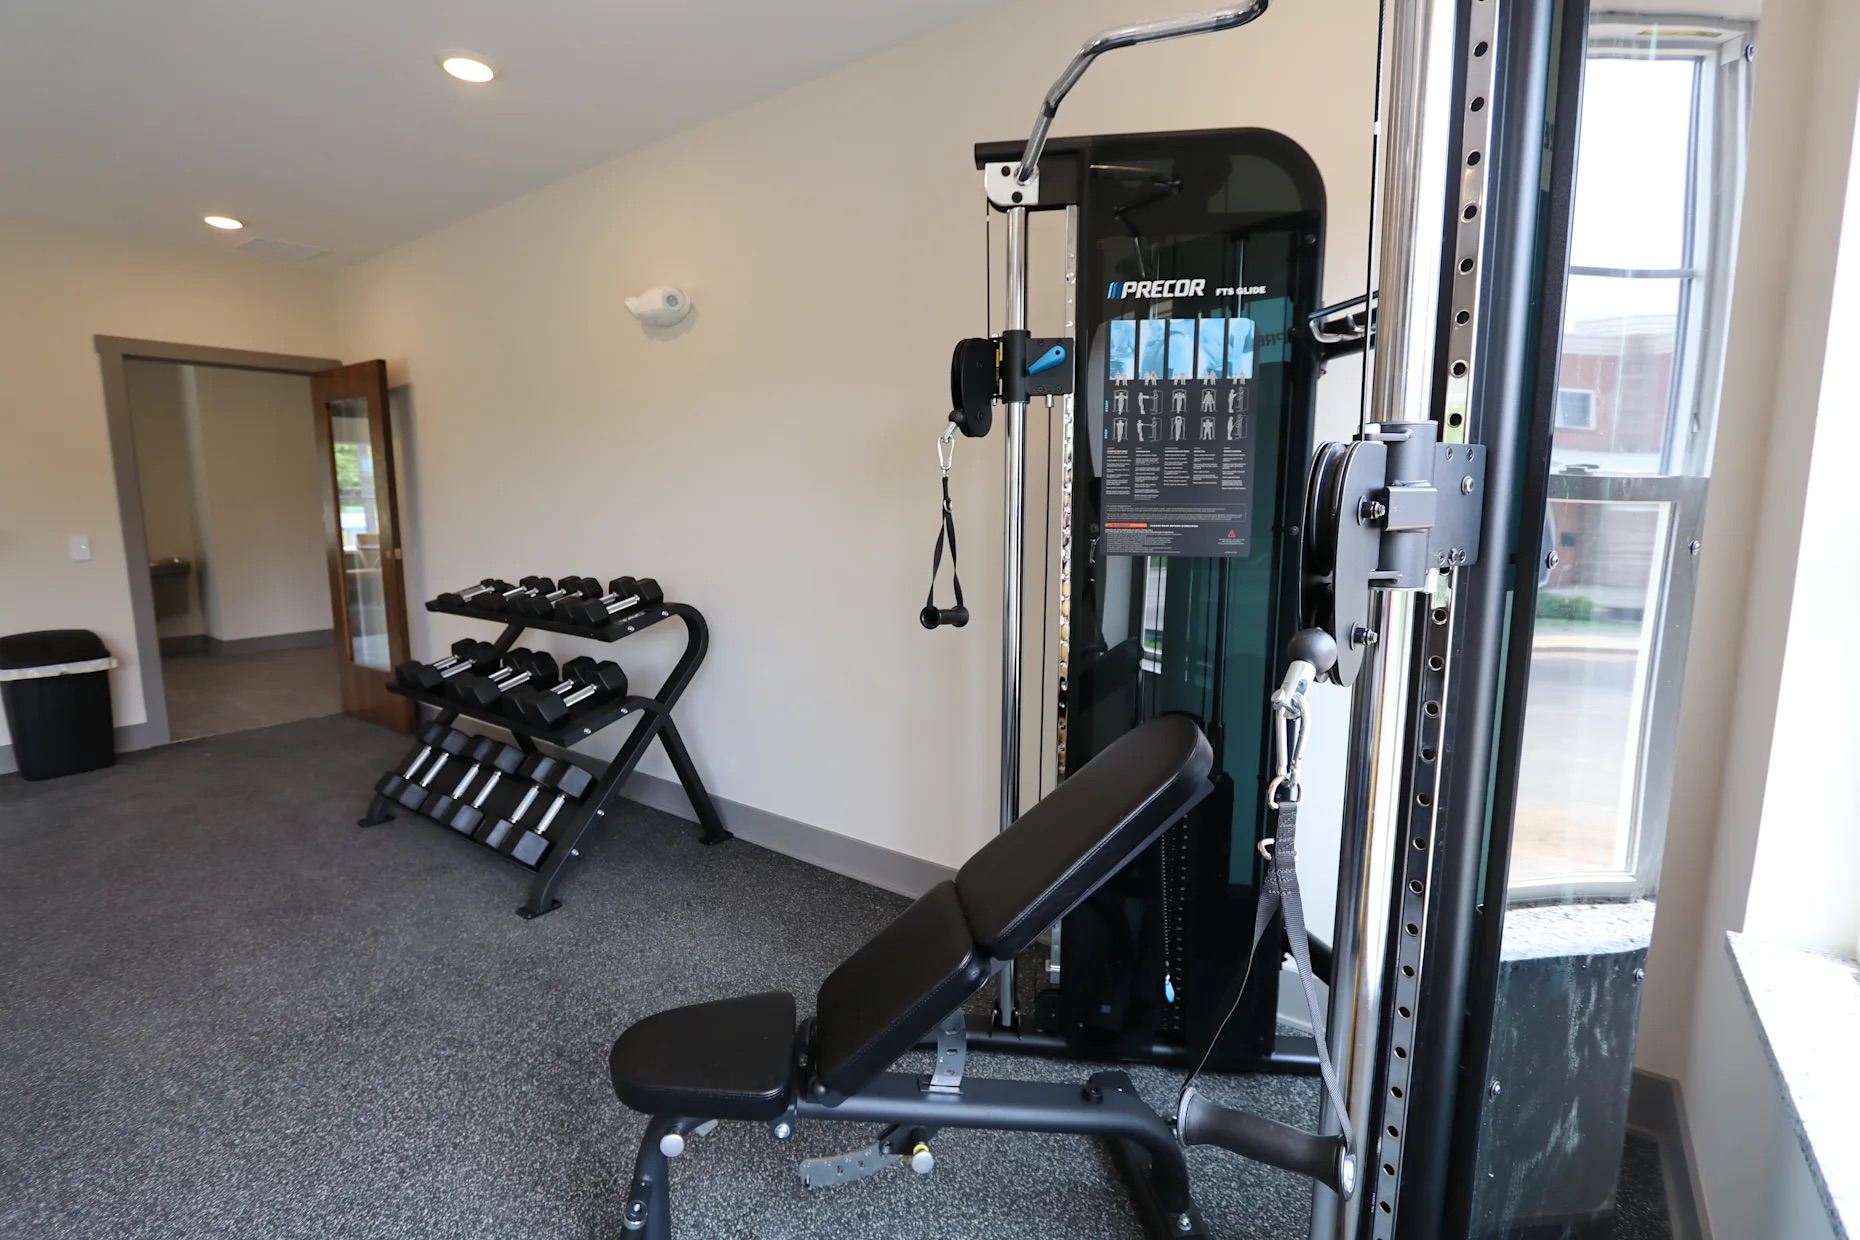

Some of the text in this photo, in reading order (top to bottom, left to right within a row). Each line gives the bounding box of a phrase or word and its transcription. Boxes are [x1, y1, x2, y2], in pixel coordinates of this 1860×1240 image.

[1121, 279, 1206, 299] PRECOR
[1215, 286, 1266, 297] FTS GLIDE
